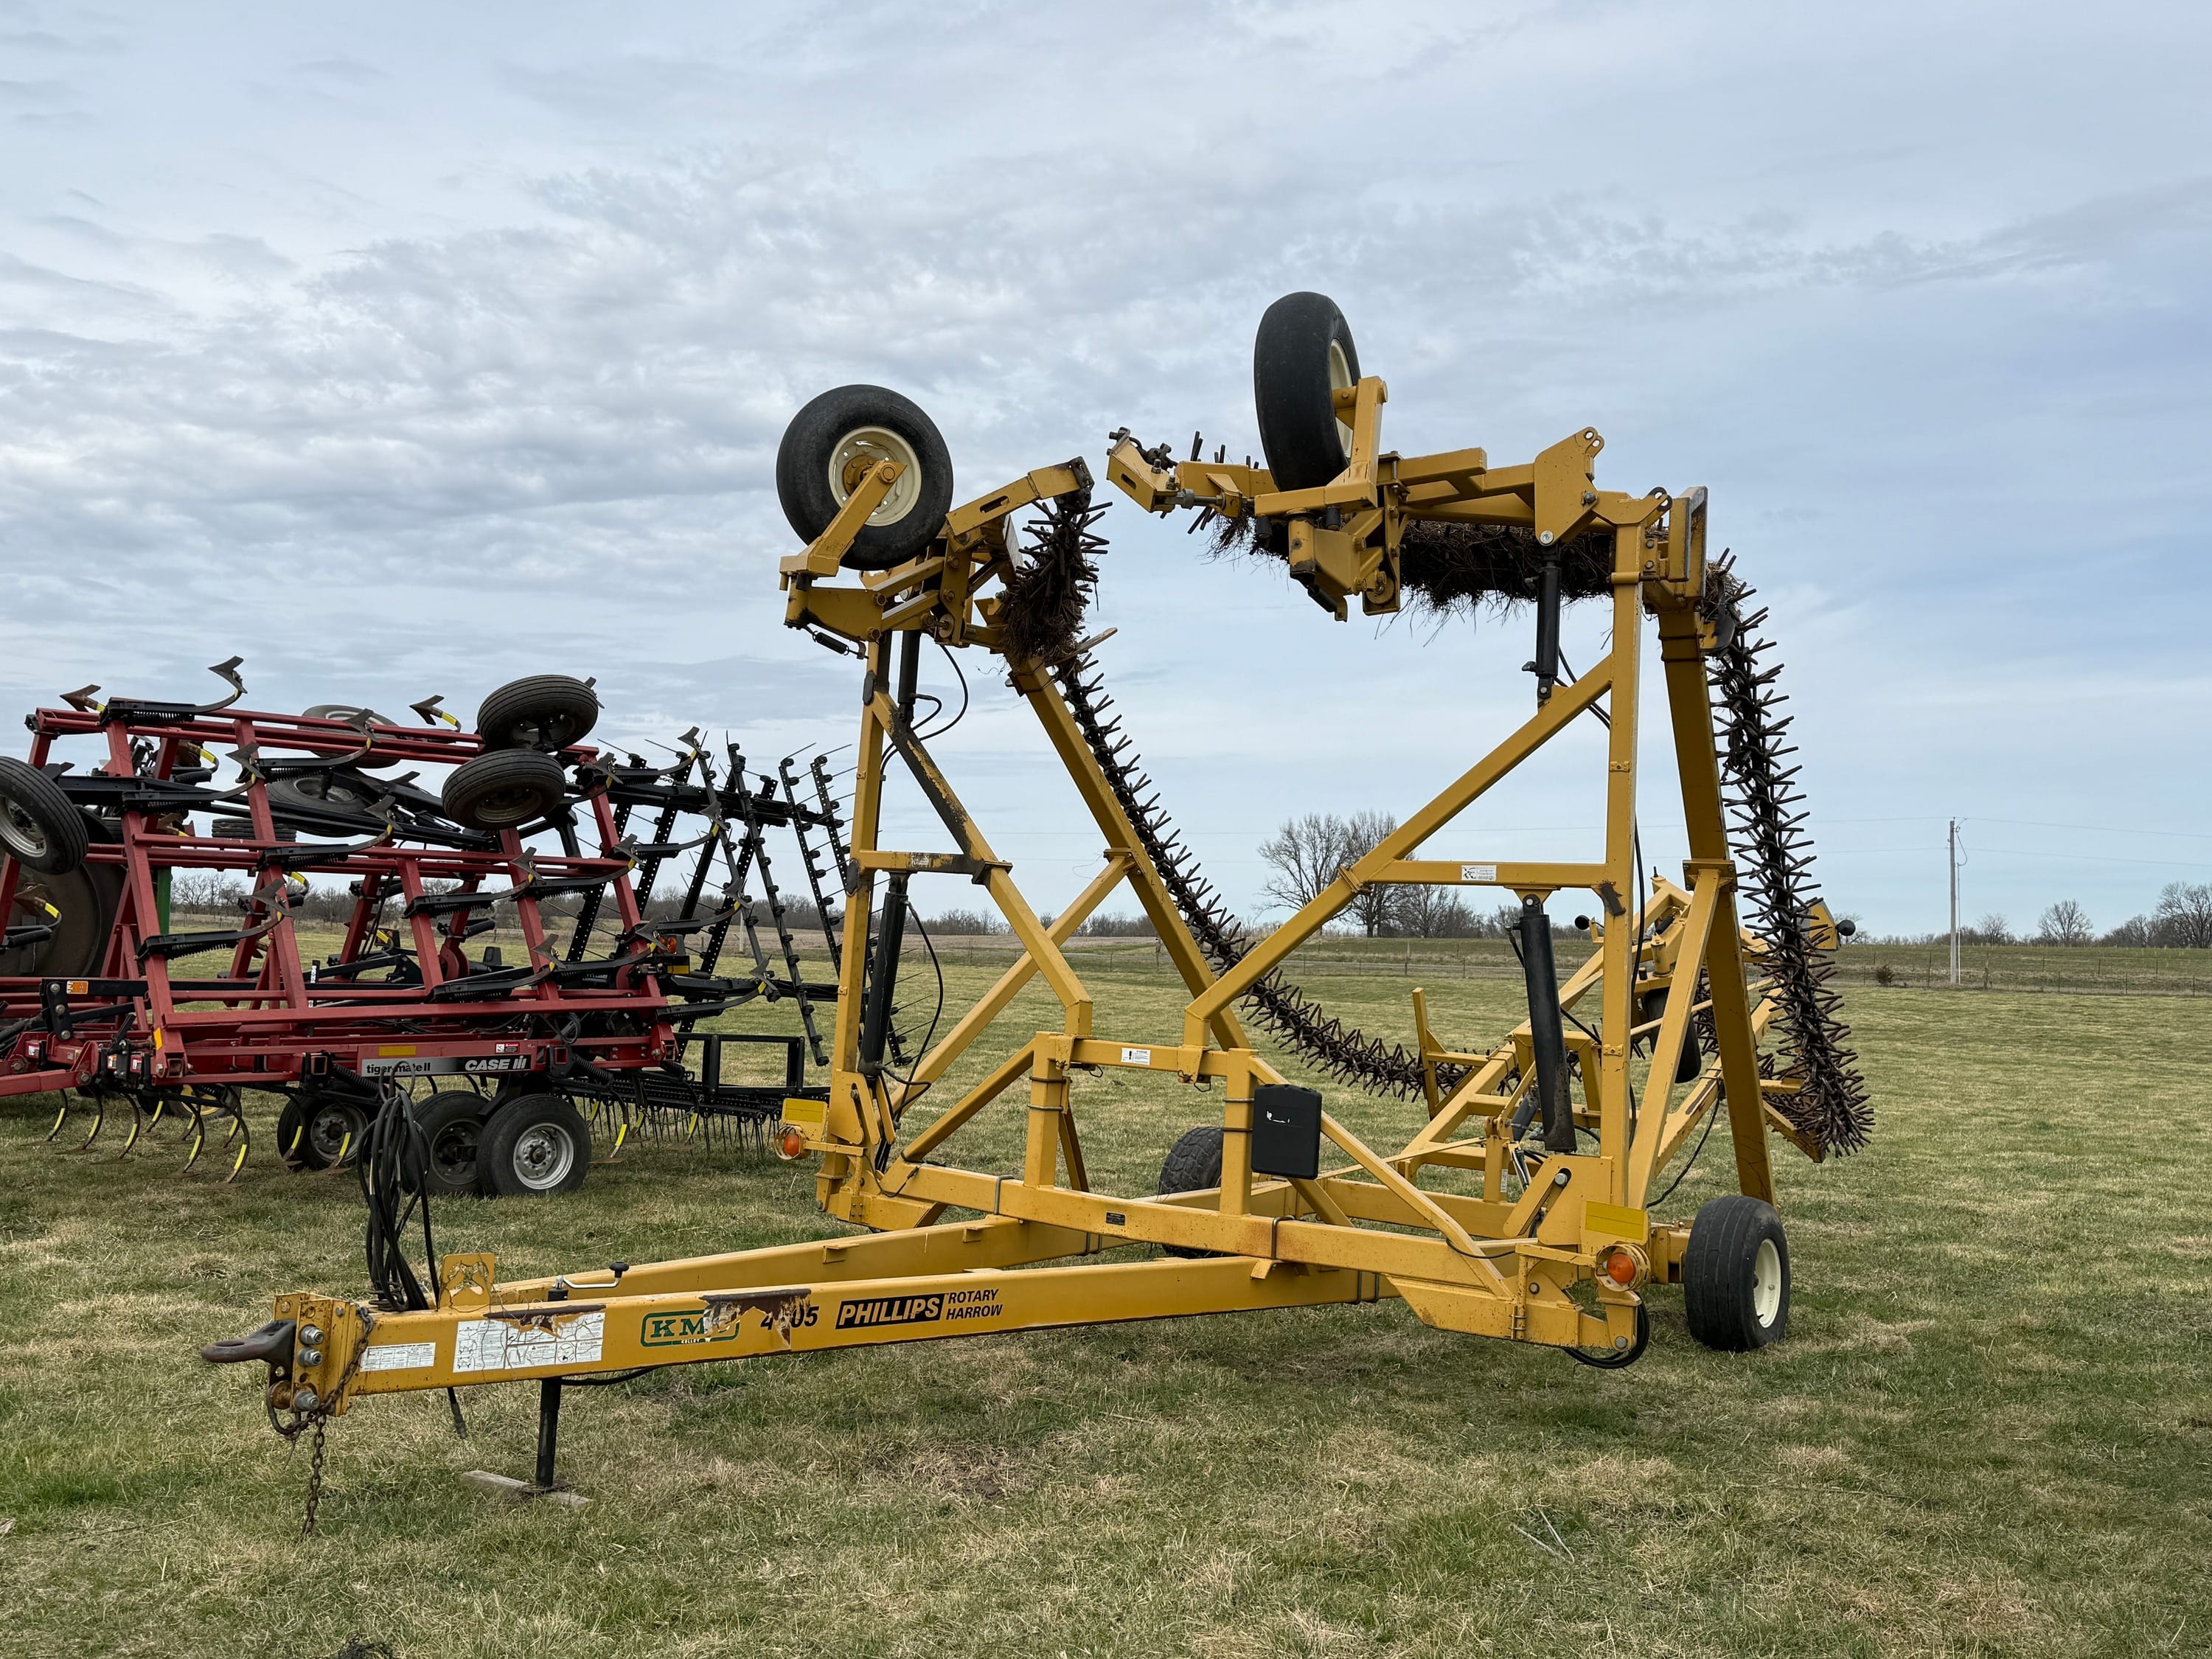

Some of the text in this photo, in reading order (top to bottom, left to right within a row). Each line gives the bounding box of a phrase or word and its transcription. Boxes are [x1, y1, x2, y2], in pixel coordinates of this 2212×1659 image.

[465, 1059, 510, 1071] CASE
[948, 1288, 999, 1304] ROTARY
[760, 1306, 820, 1330] 405
[838, 1297, 940, 1326] PHILLIPS
[946, 1304, 1003, 1320] HARROW
